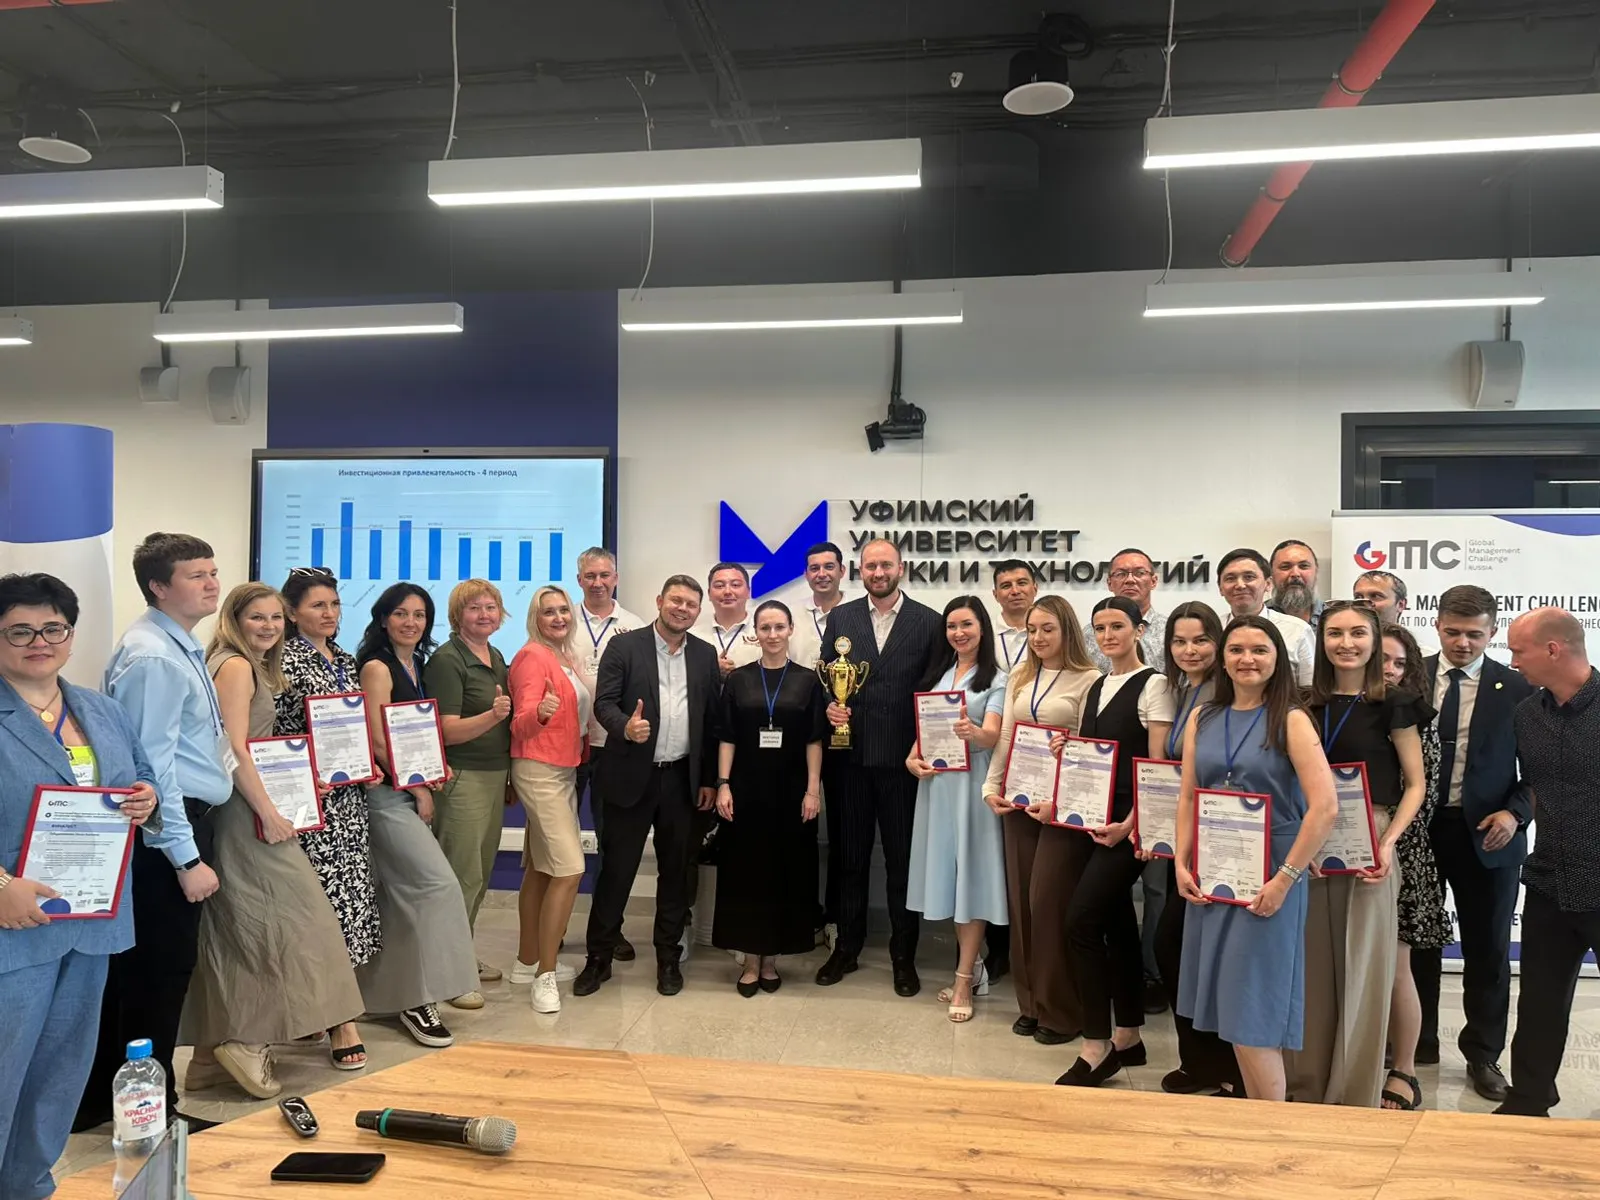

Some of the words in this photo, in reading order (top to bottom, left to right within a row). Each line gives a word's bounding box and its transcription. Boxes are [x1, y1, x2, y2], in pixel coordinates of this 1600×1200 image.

[338, 469, 401, 477] Инвестиционная
[402, 469, 476, 478] привлекательность
[489, 469, 518, 478] период
[849, 493, 1034, 522] УФИМСКИЙ
[1468, 547, 1521, 555] Management
[1468, 555, 1508, 563] Challenge
[849, 560, 949, 583] НКИ
[960, 561, 979, 583] И
[1416, 595, 1523, 611] MAENT
[1528, 595, 1600, 612] CHALLEN
[124, 1100, 162, 1118] КРАСНЫЙ
[131, 1113, 158, 1125] КЛЮЧ
